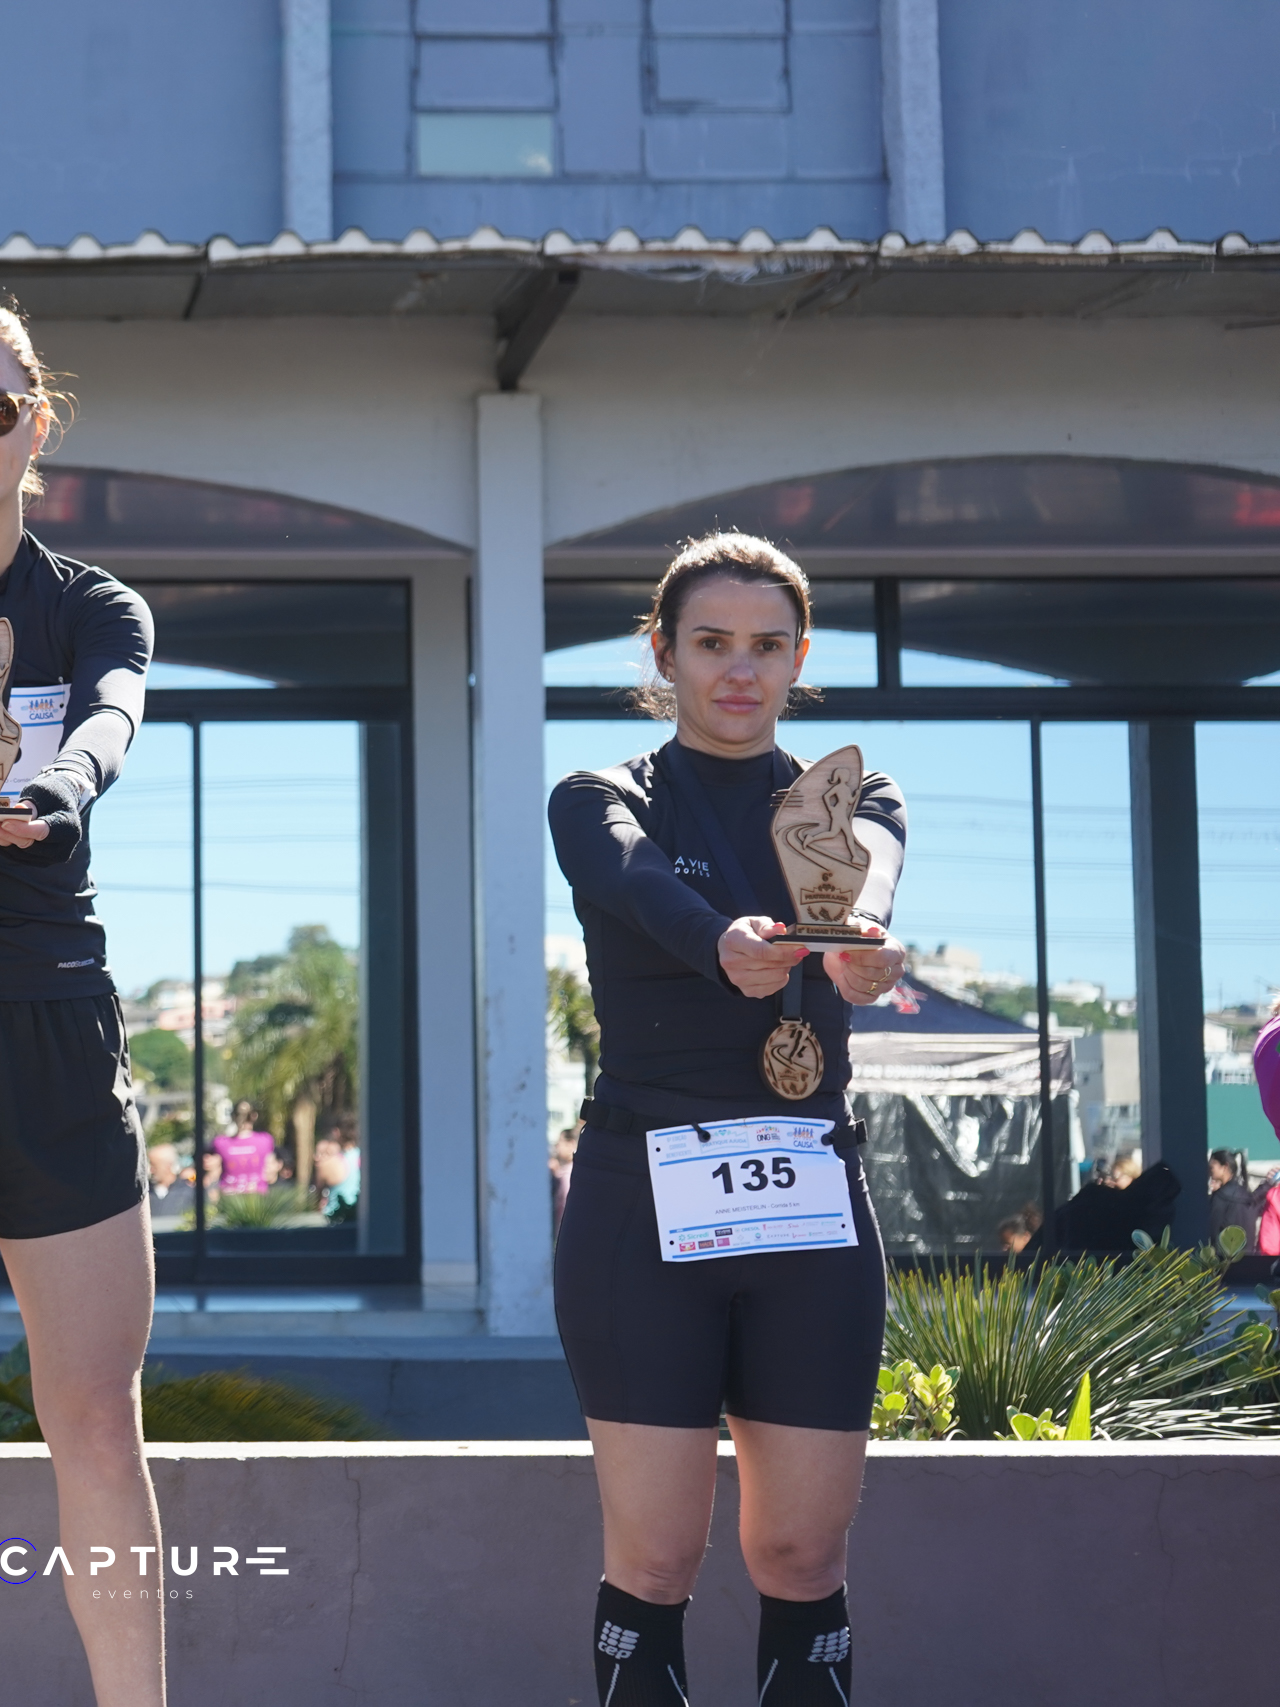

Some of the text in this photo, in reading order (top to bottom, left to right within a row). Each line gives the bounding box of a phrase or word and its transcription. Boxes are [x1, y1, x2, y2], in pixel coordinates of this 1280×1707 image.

[29, 712, 54, 720] CAUSA
[689, 858, 709, 871] VIE
[675, 866, 710, 877] ports
[793, 1140, 814, 1149] CAUSA
[712, 1157, 796, 1194] 135
[686, 1231, 709, 1240] Sicredi
[598, 1641, 632, 1660] cep
[807, 1649, 849, 1662] cep
